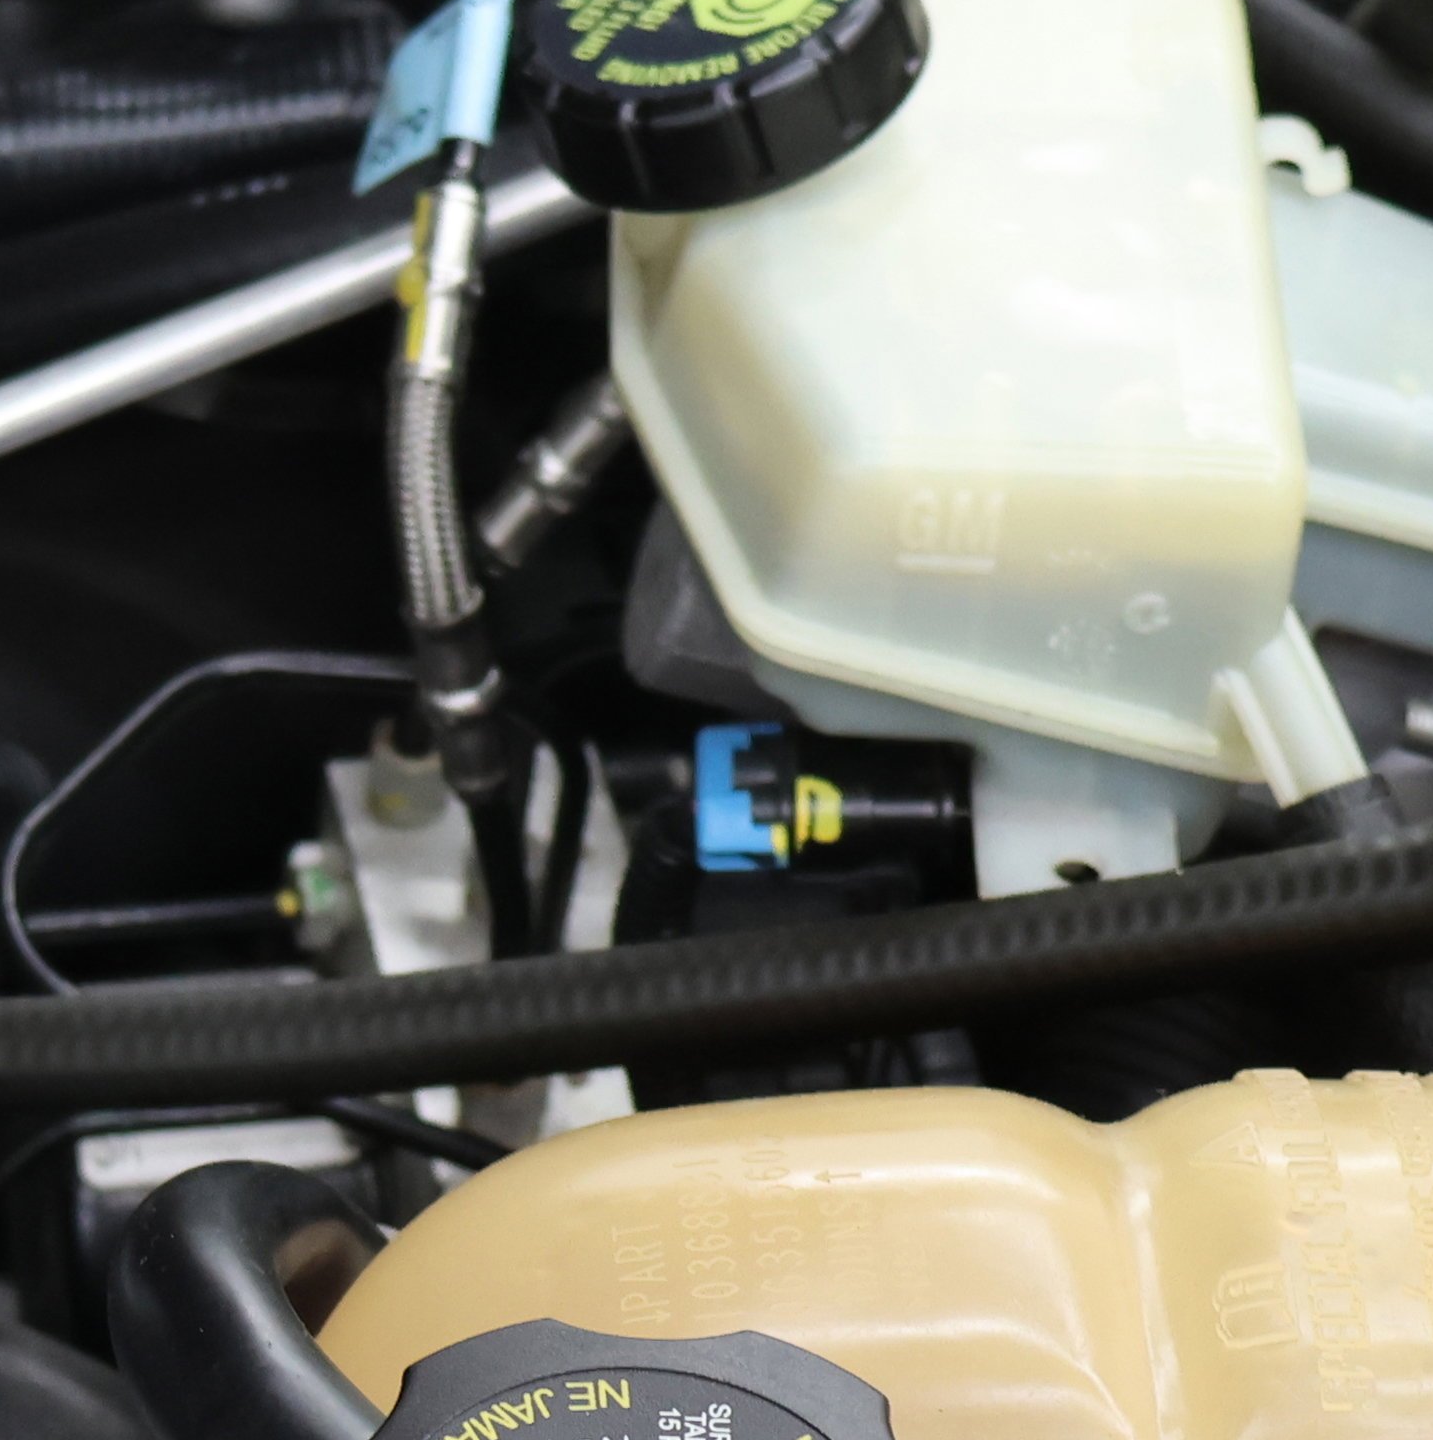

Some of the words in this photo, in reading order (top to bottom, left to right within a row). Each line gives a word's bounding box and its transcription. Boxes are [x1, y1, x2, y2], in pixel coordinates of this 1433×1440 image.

[571, 10, 633, 62] FLUID
[744, 2, 837, 65] BEFORE
[597, 53, 741, 86] REMOVING
[567, 1379, 631, 1412] NE
[658, 1408, 681, 1435] 15
